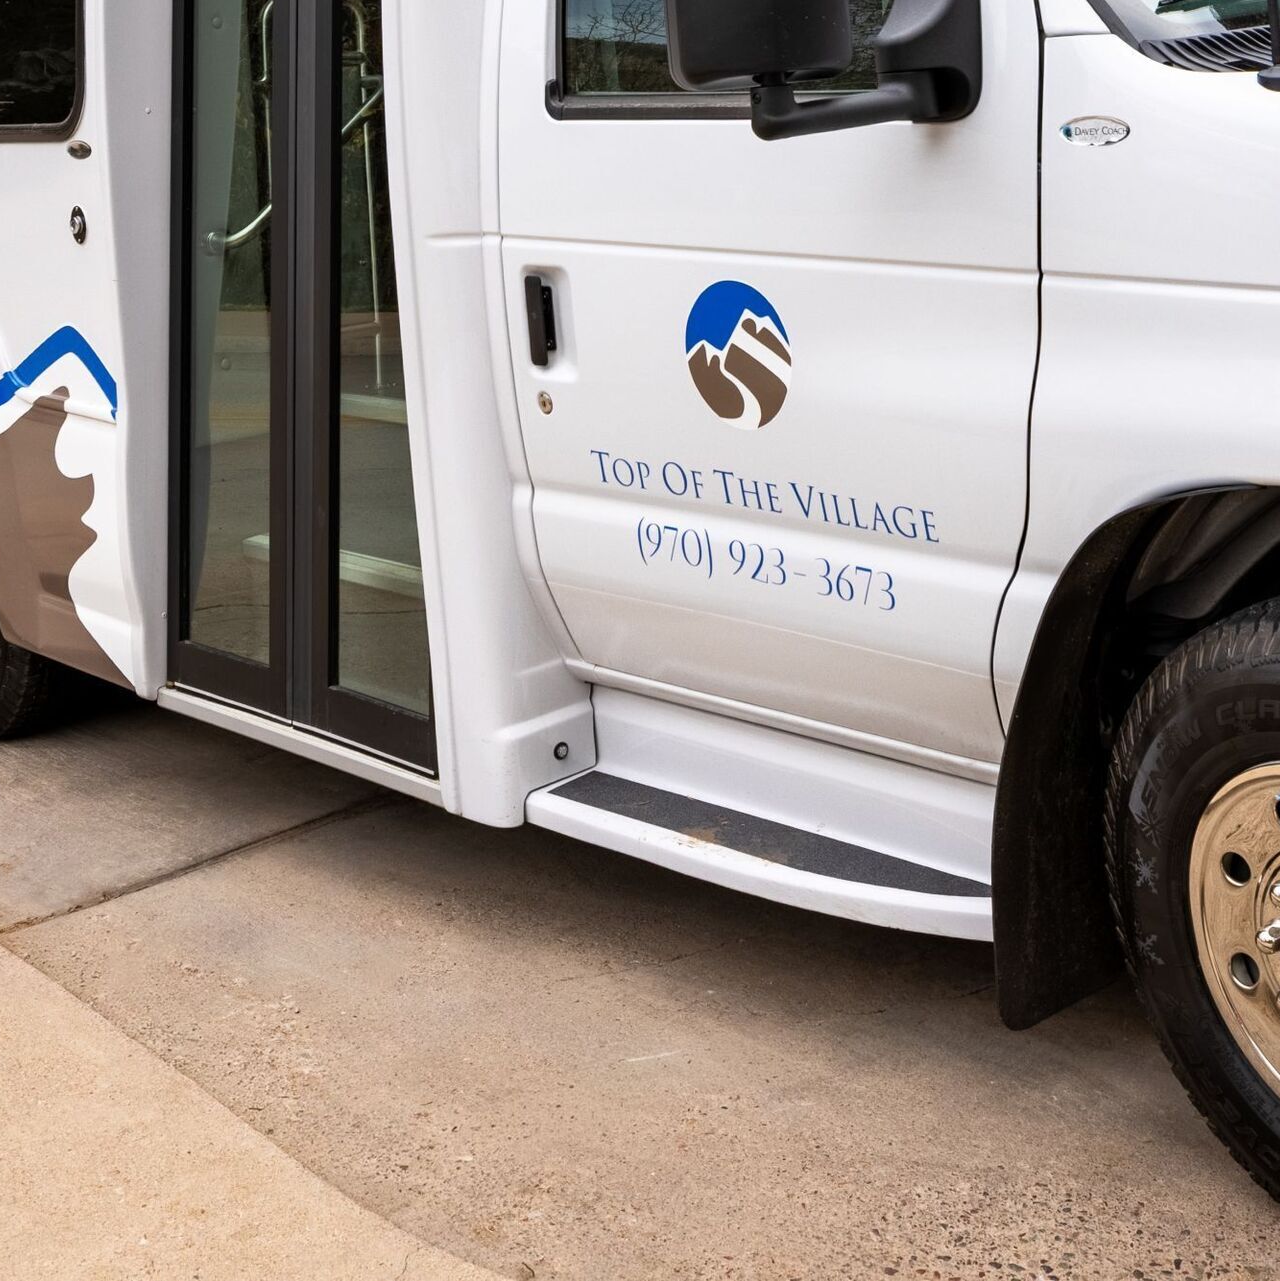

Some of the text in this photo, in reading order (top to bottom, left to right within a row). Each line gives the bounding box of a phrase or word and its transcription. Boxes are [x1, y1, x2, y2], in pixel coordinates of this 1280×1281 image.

[1074, 125, 1128, 136] DAVEY COACH
[590, 449, 941, 543] TOP OF THE VILLAGE
[636, 517, 714, 580] (970)
